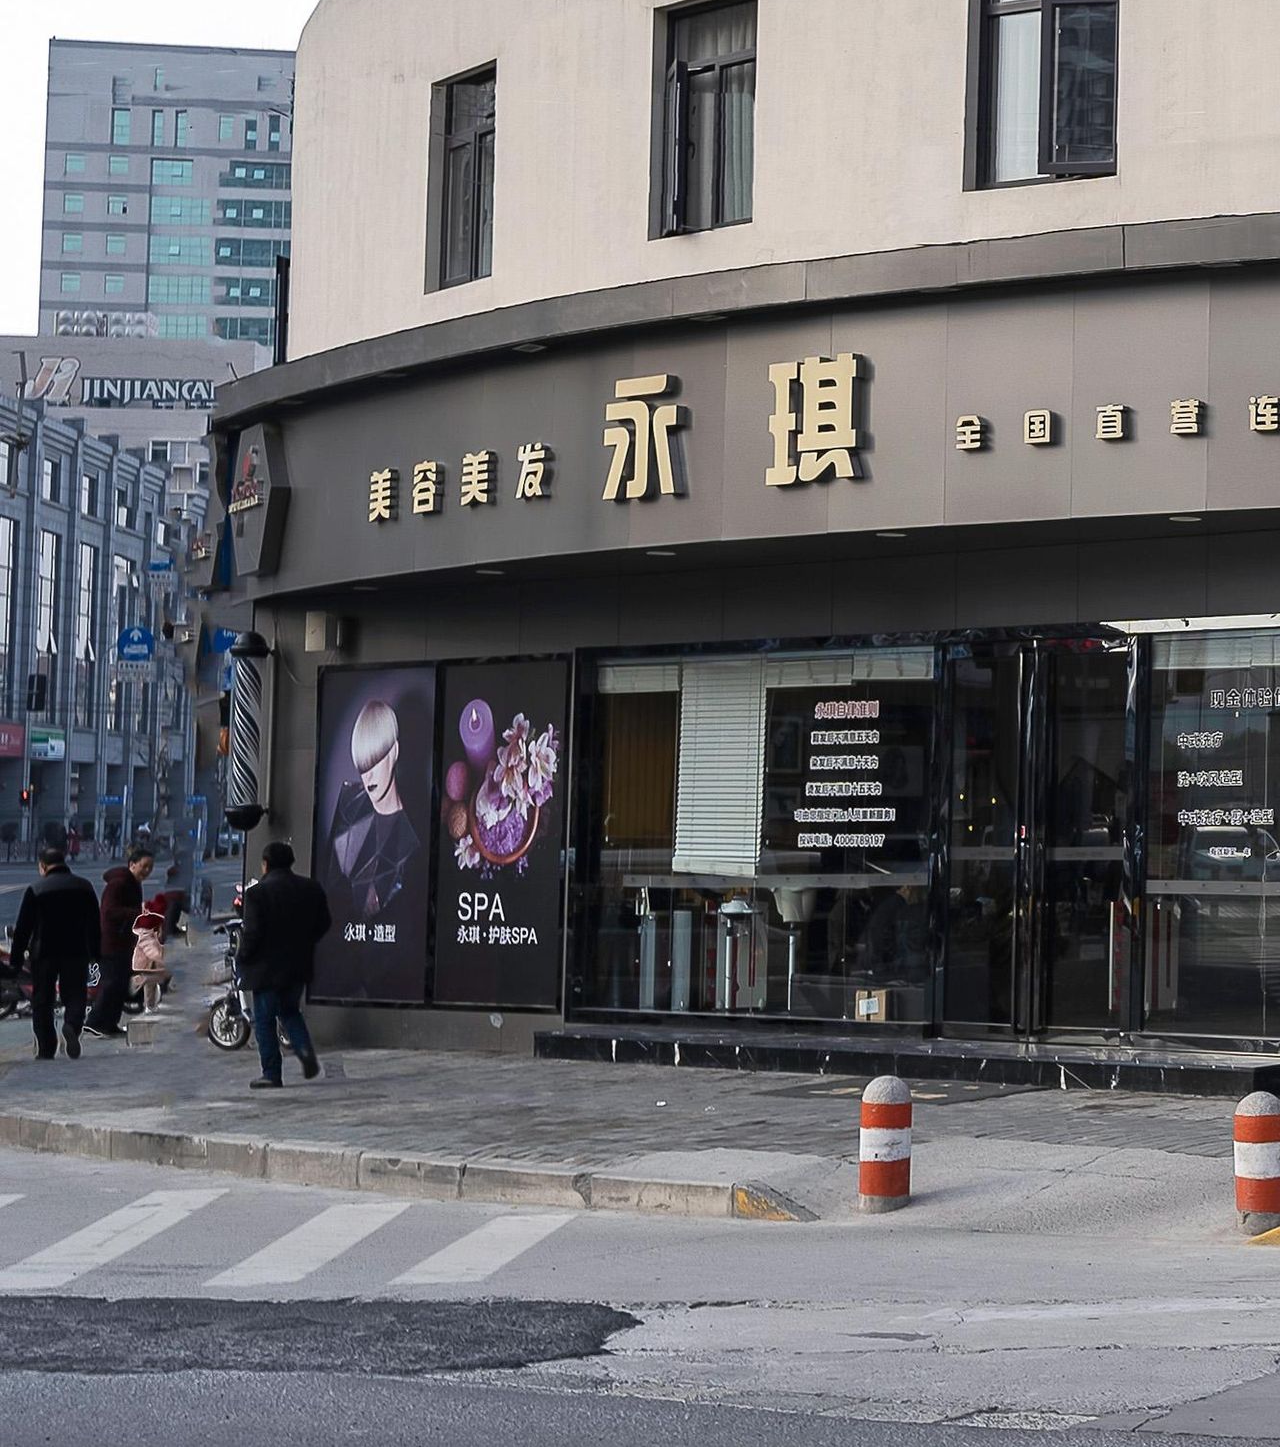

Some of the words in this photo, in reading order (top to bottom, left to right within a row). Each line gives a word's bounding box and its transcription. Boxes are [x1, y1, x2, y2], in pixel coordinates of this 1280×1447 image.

[368, 442, 549, 522] 美容美发
[602, 352, 861, 501] 永琪
[457, 892, 505, 921] SPA
